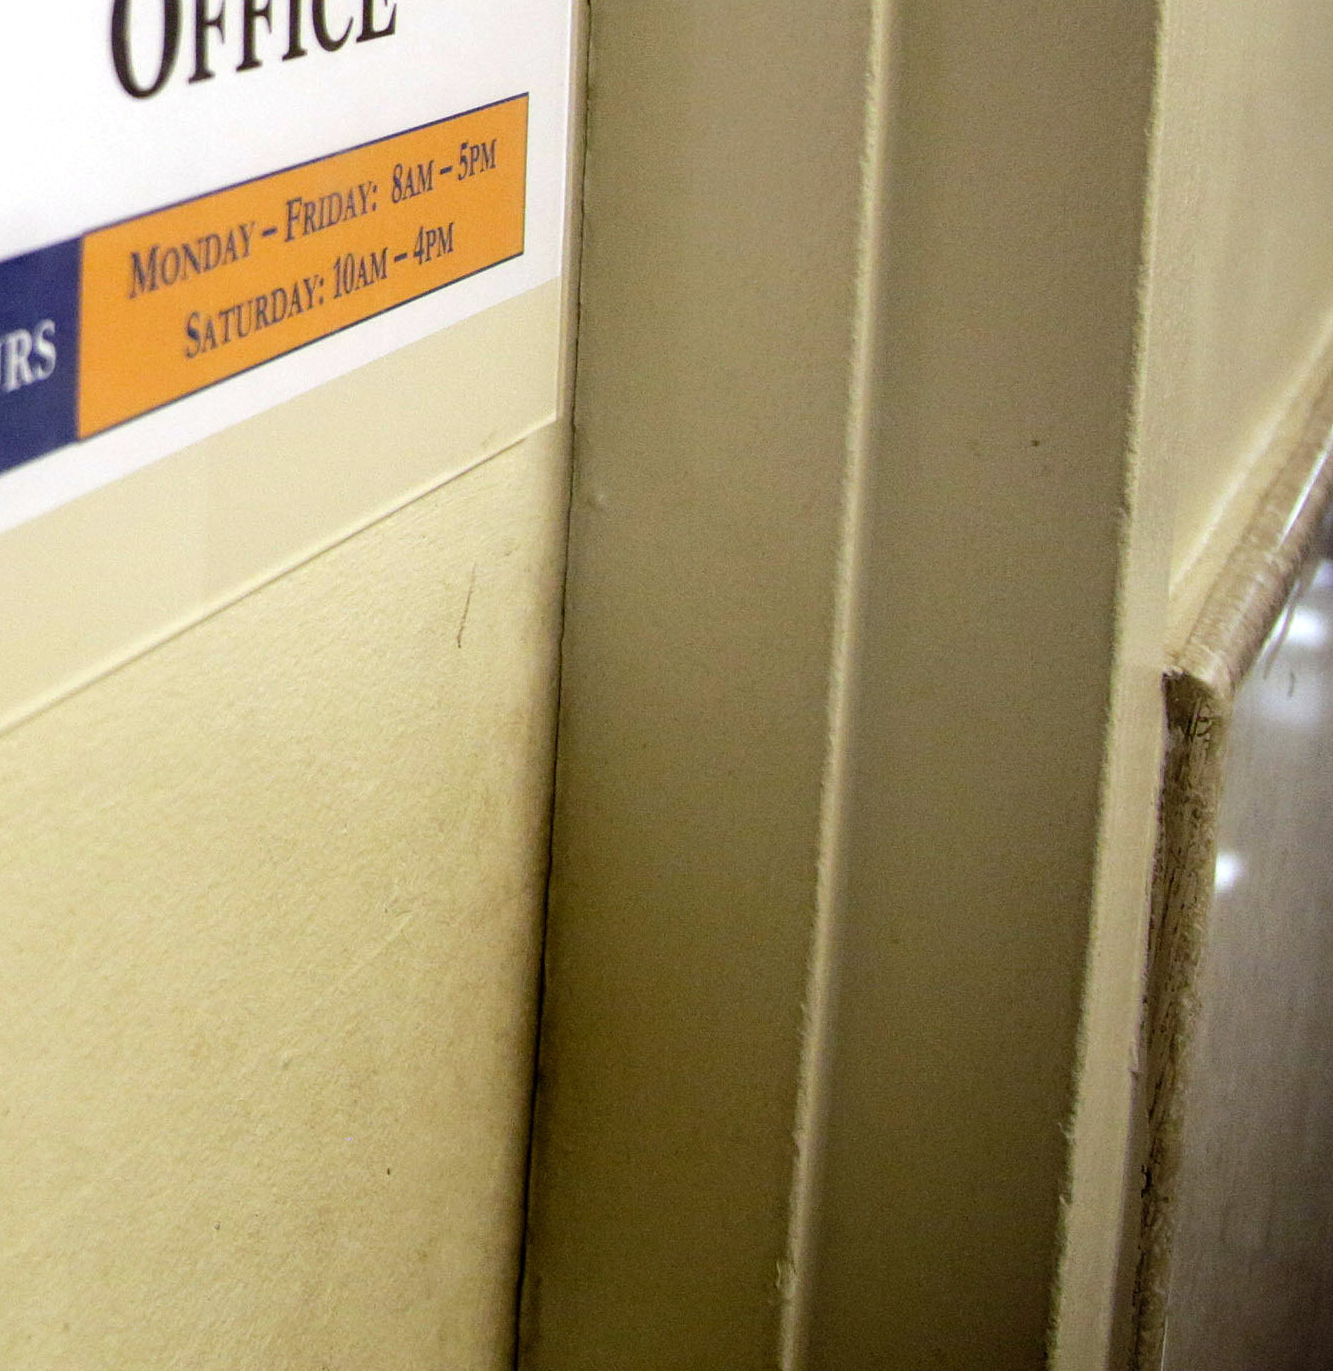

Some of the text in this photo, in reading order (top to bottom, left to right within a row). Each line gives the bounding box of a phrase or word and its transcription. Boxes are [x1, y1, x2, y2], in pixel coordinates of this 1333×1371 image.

[129, 221, 256, 299] MONDAY
[284, 181, 378, 242] FRIDAY:
[391, 160, 434, 204] 8AM
[458, 139, 496, 181] 5PM
[185, 273, 325, 359] SATURDAY:
[333, 248, 388, 299] 10AM
[412, 223, 454, 265] 4PM
